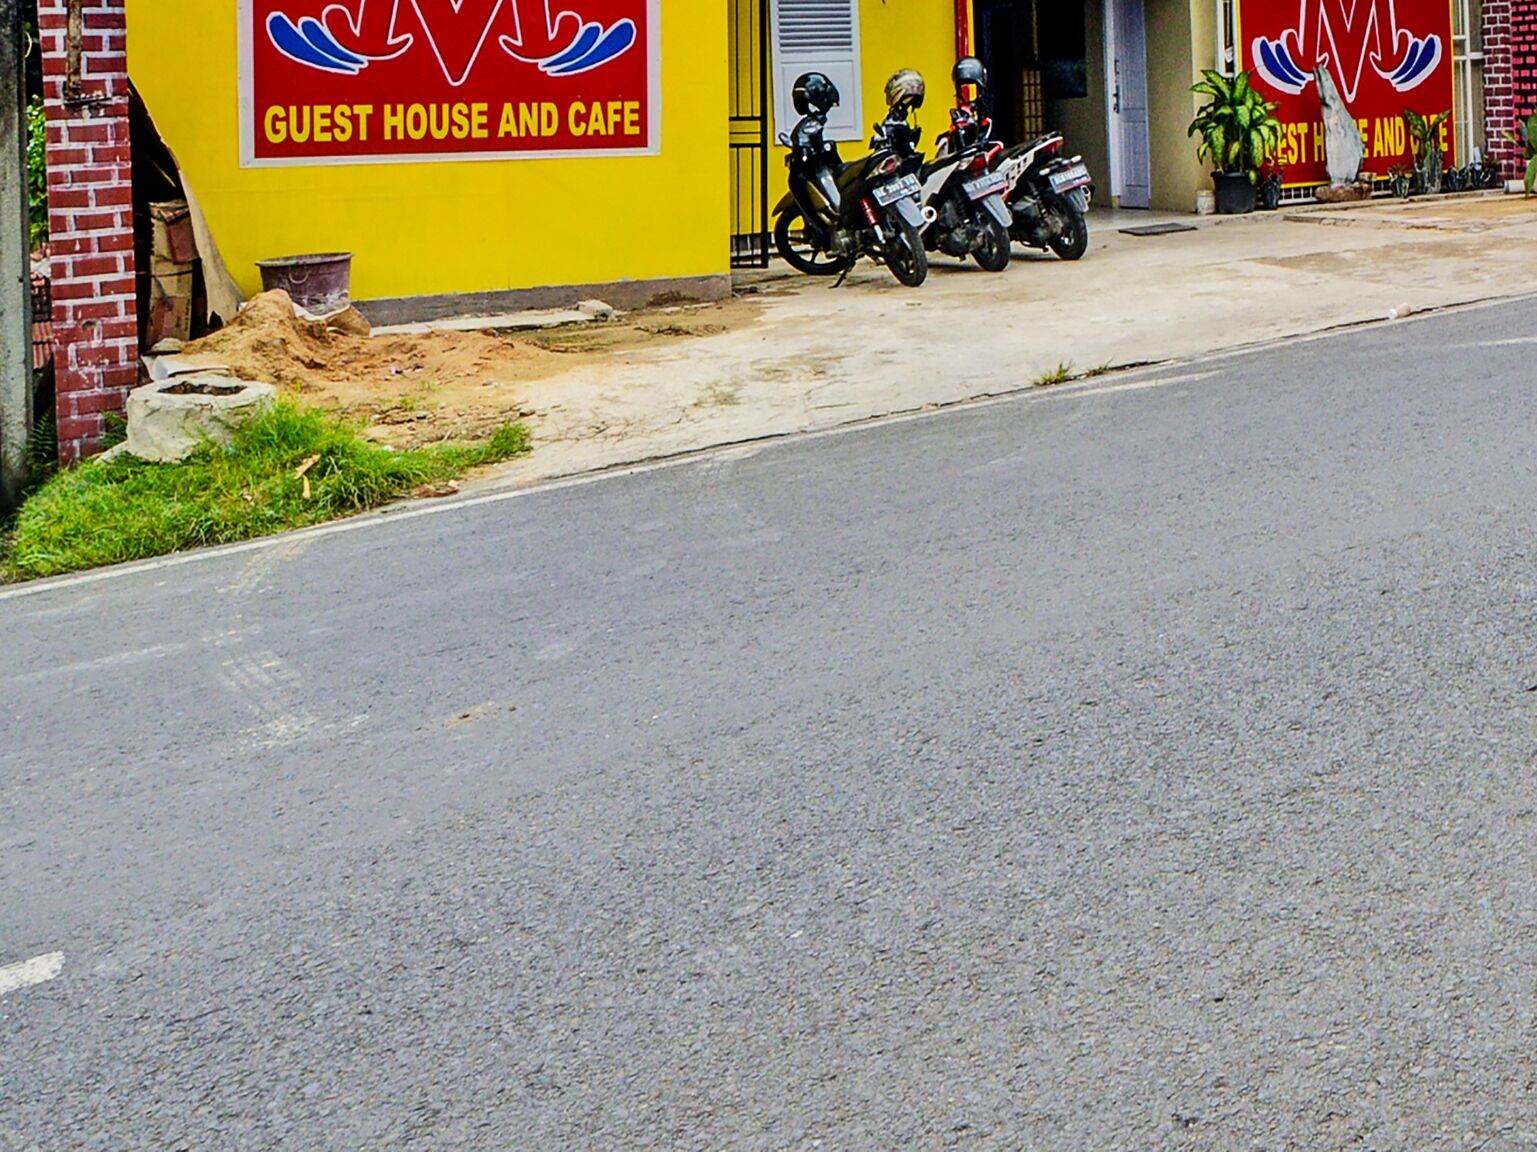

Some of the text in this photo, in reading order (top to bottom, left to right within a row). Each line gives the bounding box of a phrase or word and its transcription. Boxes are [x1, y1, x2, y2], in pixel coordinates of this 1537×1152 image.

[264, 101, 640, 144] GUEST HOUSE AND CAFE
[1265, 121, 1308, 165] EST
[1373, 116, 1406, 158] AND
